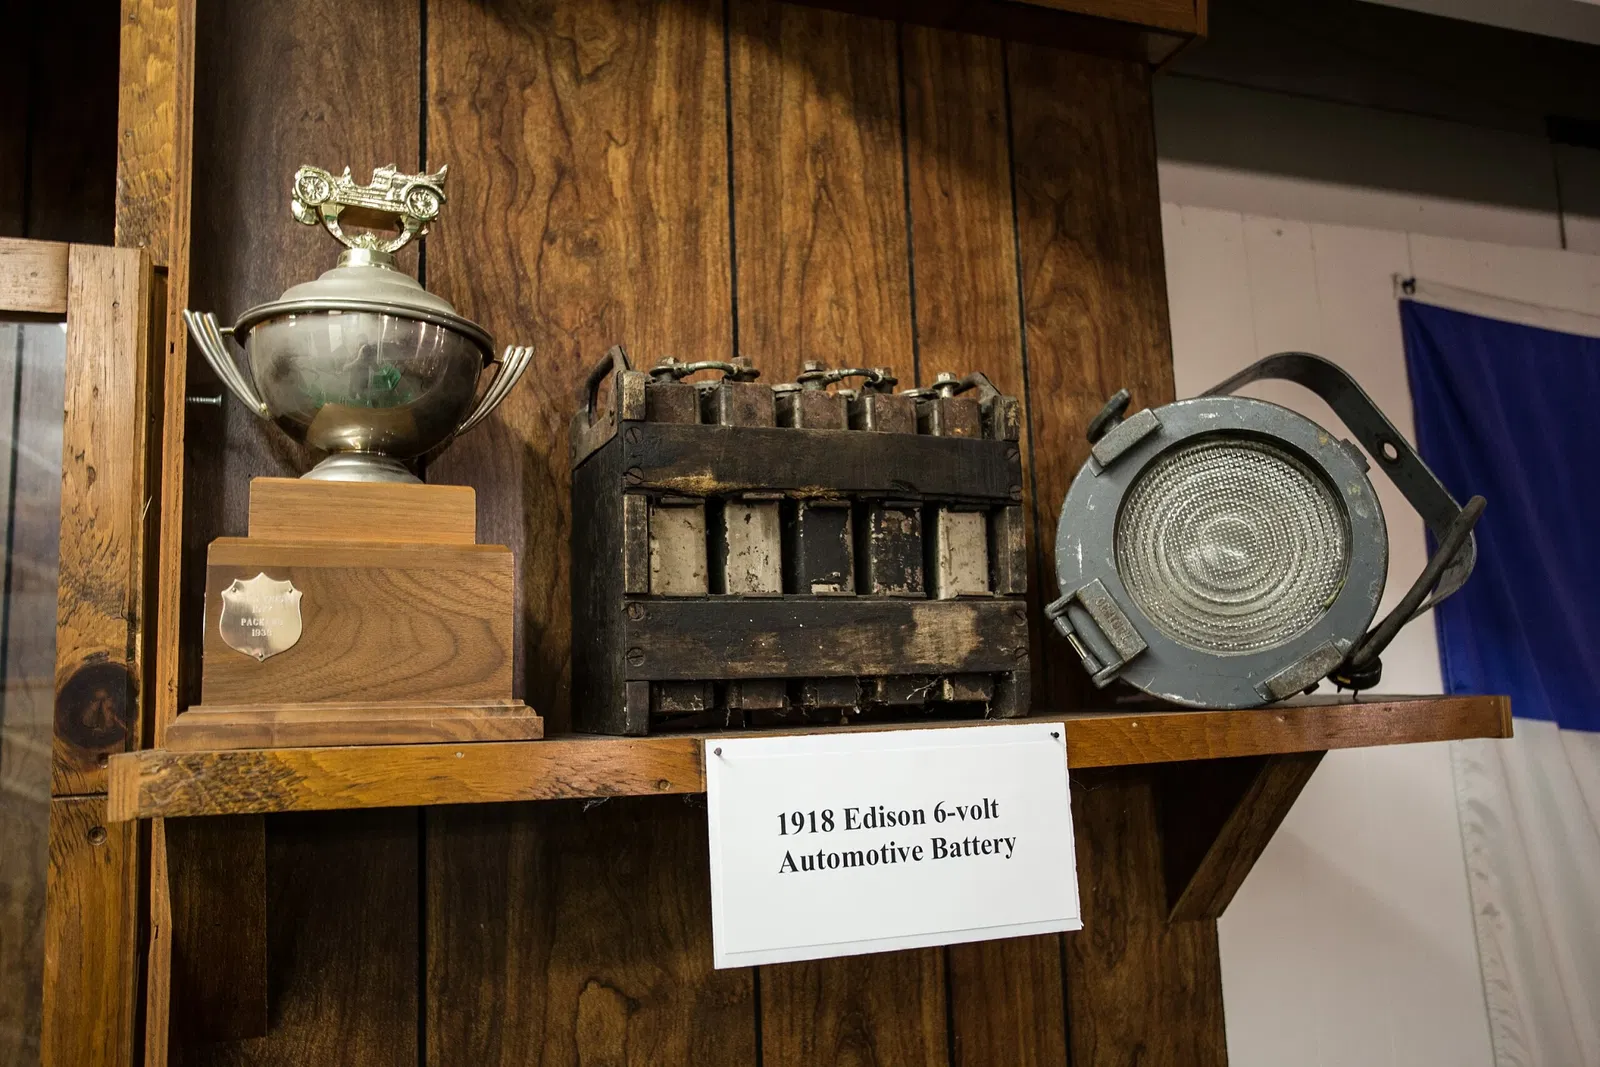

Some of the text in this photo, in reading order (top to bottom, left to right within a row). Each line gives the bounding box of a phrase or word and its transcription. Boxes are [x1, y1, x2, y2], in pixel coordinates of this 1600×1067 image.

[241, 618, 283, 626] PACK
[778, 797, 1000, 836] 1918 Edison 6-volt
[778, 836, 1017, 874] Automotive Battery
